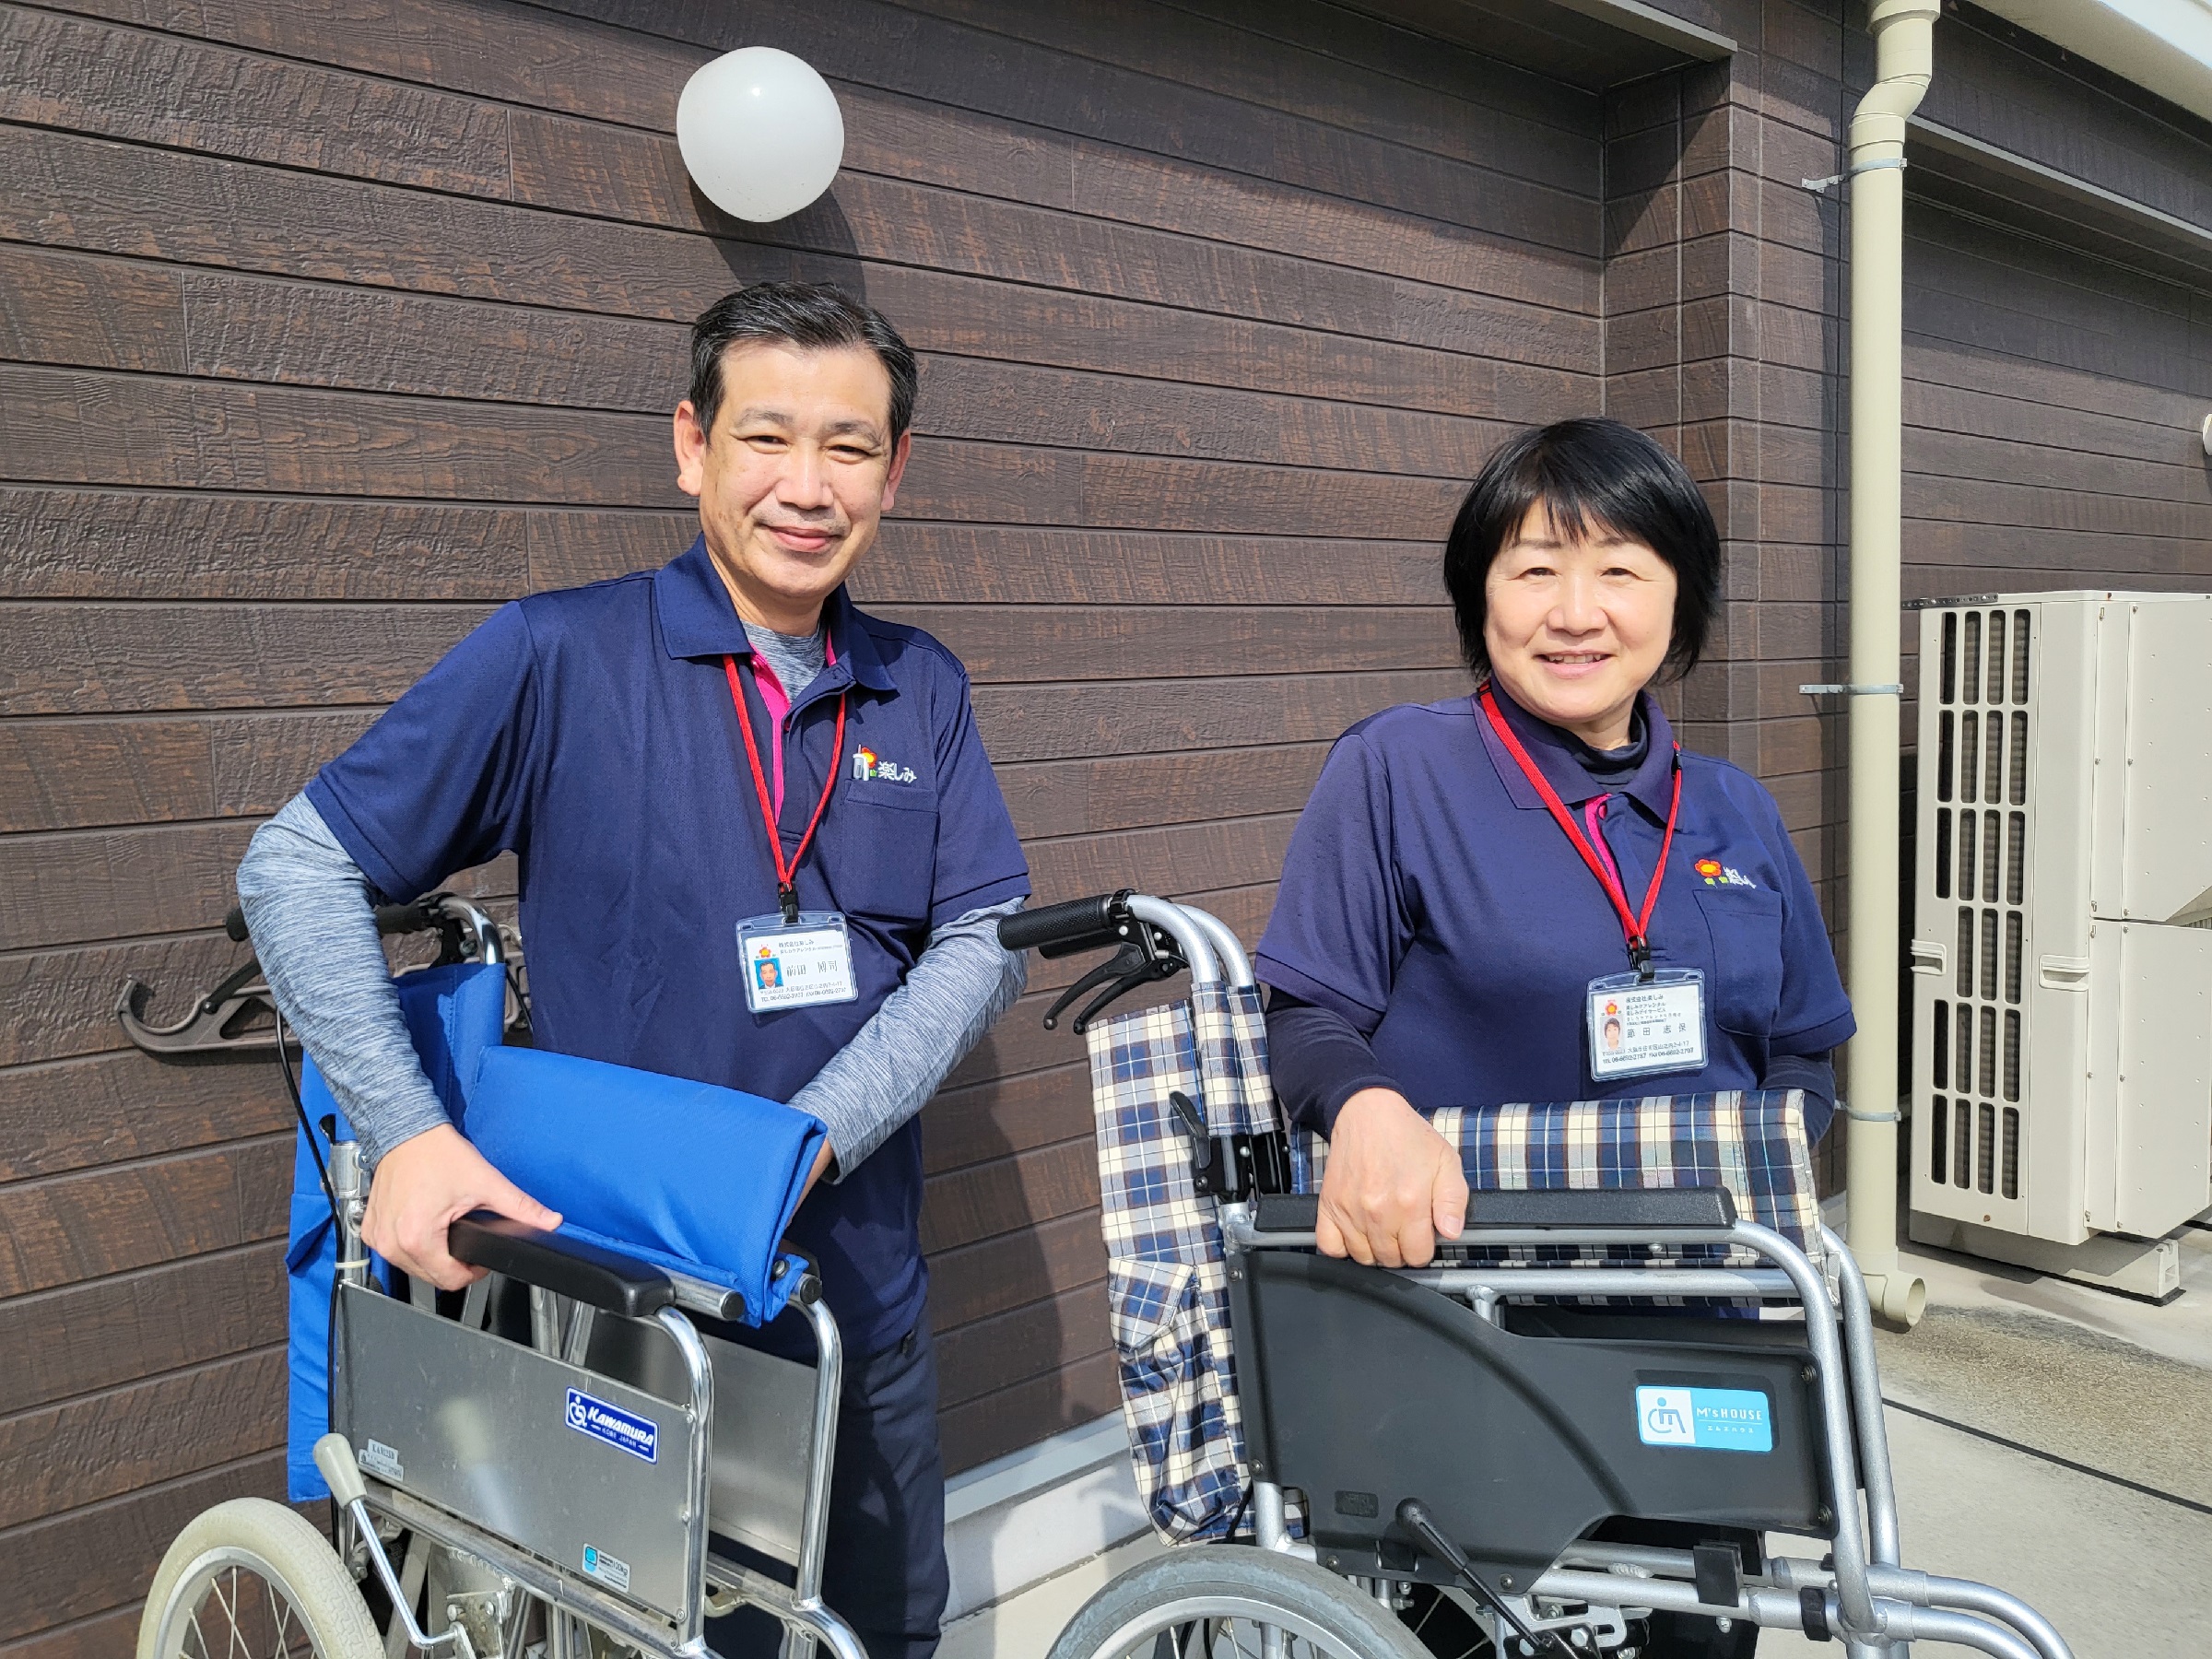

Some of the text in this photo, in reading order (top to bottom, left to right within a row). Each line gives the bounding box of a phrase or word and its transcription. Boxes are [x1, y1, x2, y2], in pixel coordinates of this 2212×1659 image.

[877, 761, 918, 784] 楽しみ
[587, 1406, 653, 1446] KAWAMURA
